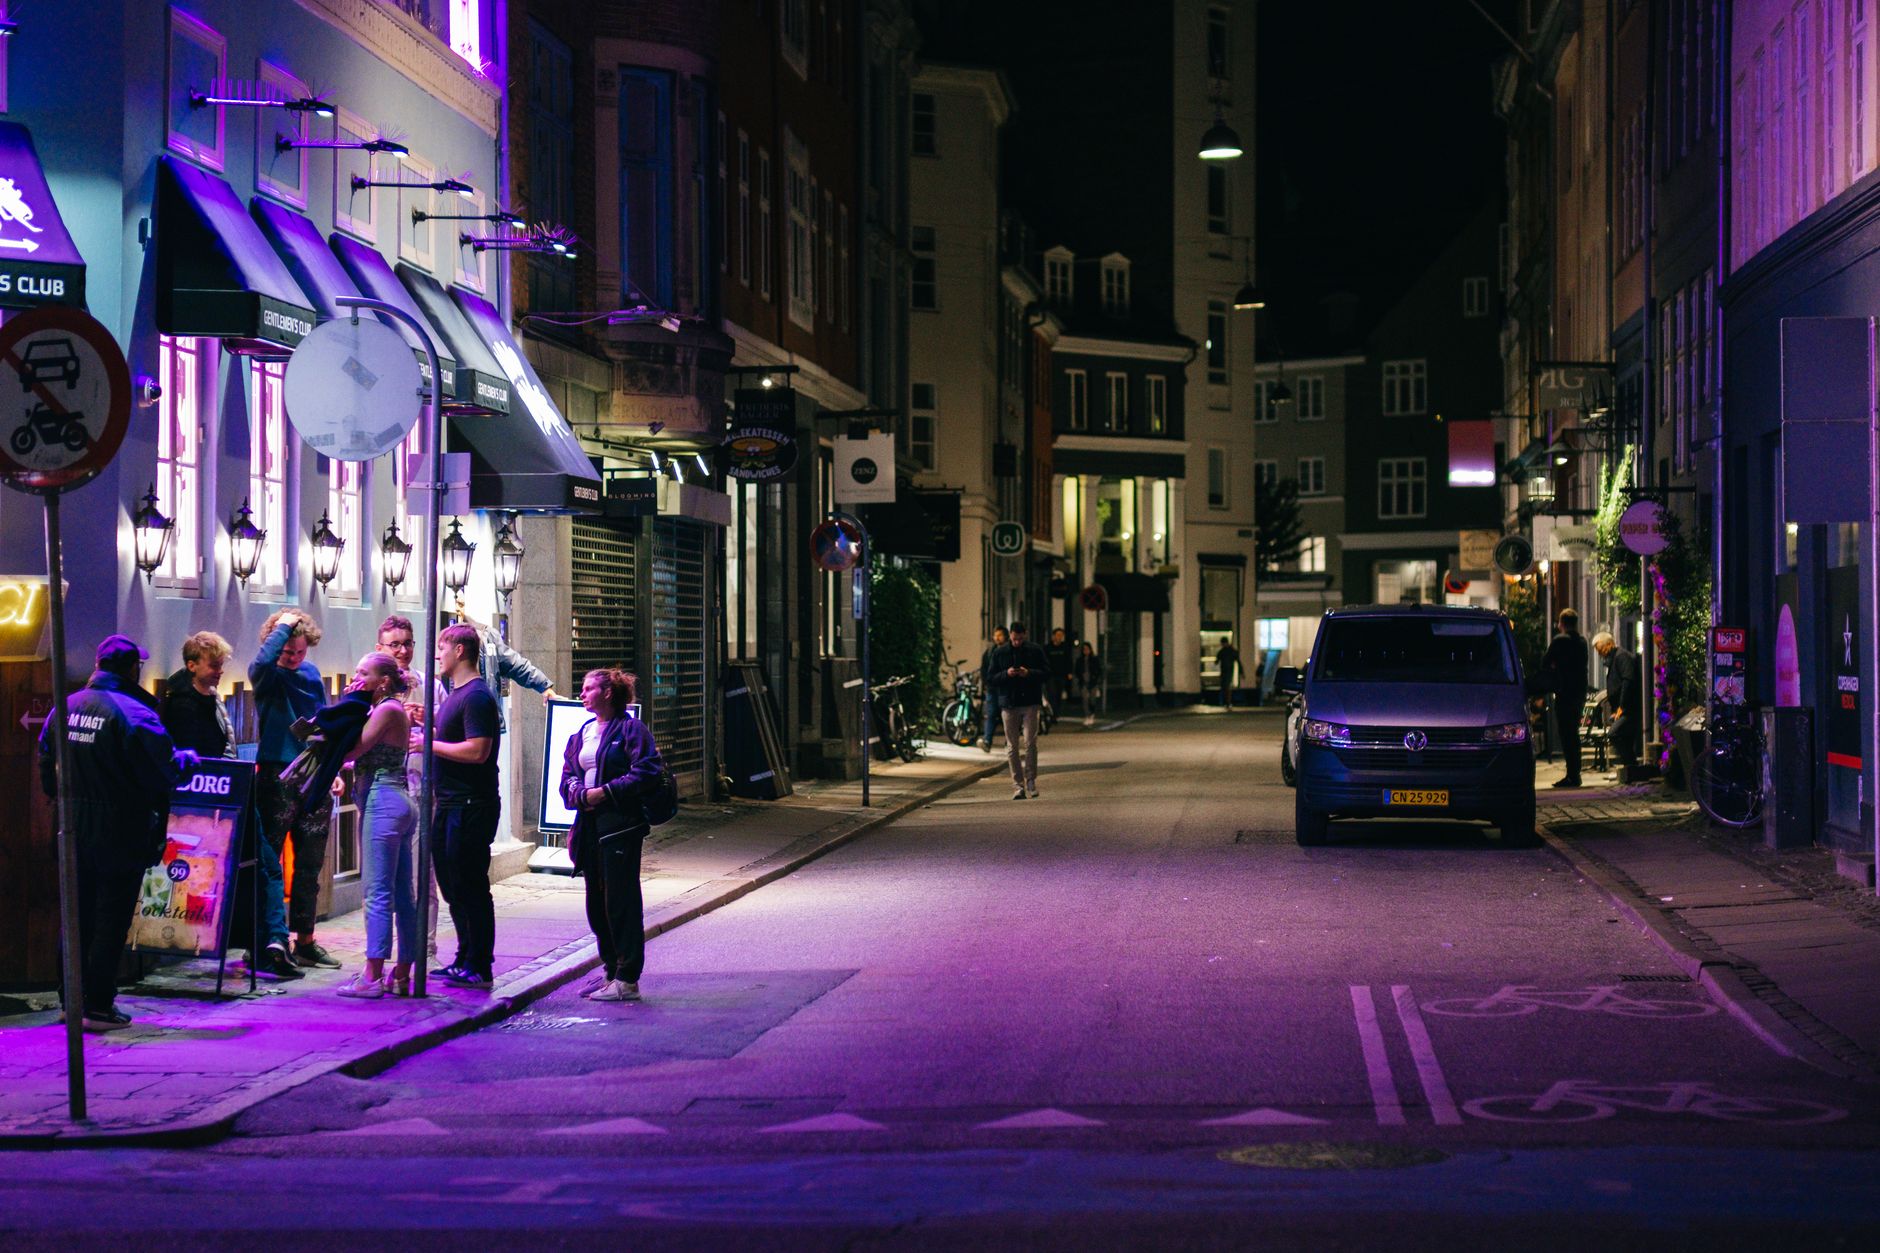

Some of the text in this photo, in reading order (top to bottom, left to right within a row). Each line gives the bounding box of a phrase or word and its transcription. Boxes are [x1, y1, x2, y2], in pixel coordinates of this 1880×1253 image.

[0, 274, 65, 296] S CLUB
[263, 309, 312, 337] GENTLEMEN'S CLUB
[608, 492, 656, 500] BLOOMING
[66, 713, 105, 730] M VAGT
[67, 731, 95, 743] rmand
[176, 774, 231, 795] ORG
[1392, 792, 1447, 804] CN 25 929
[170, 867, 187, 880] 99
